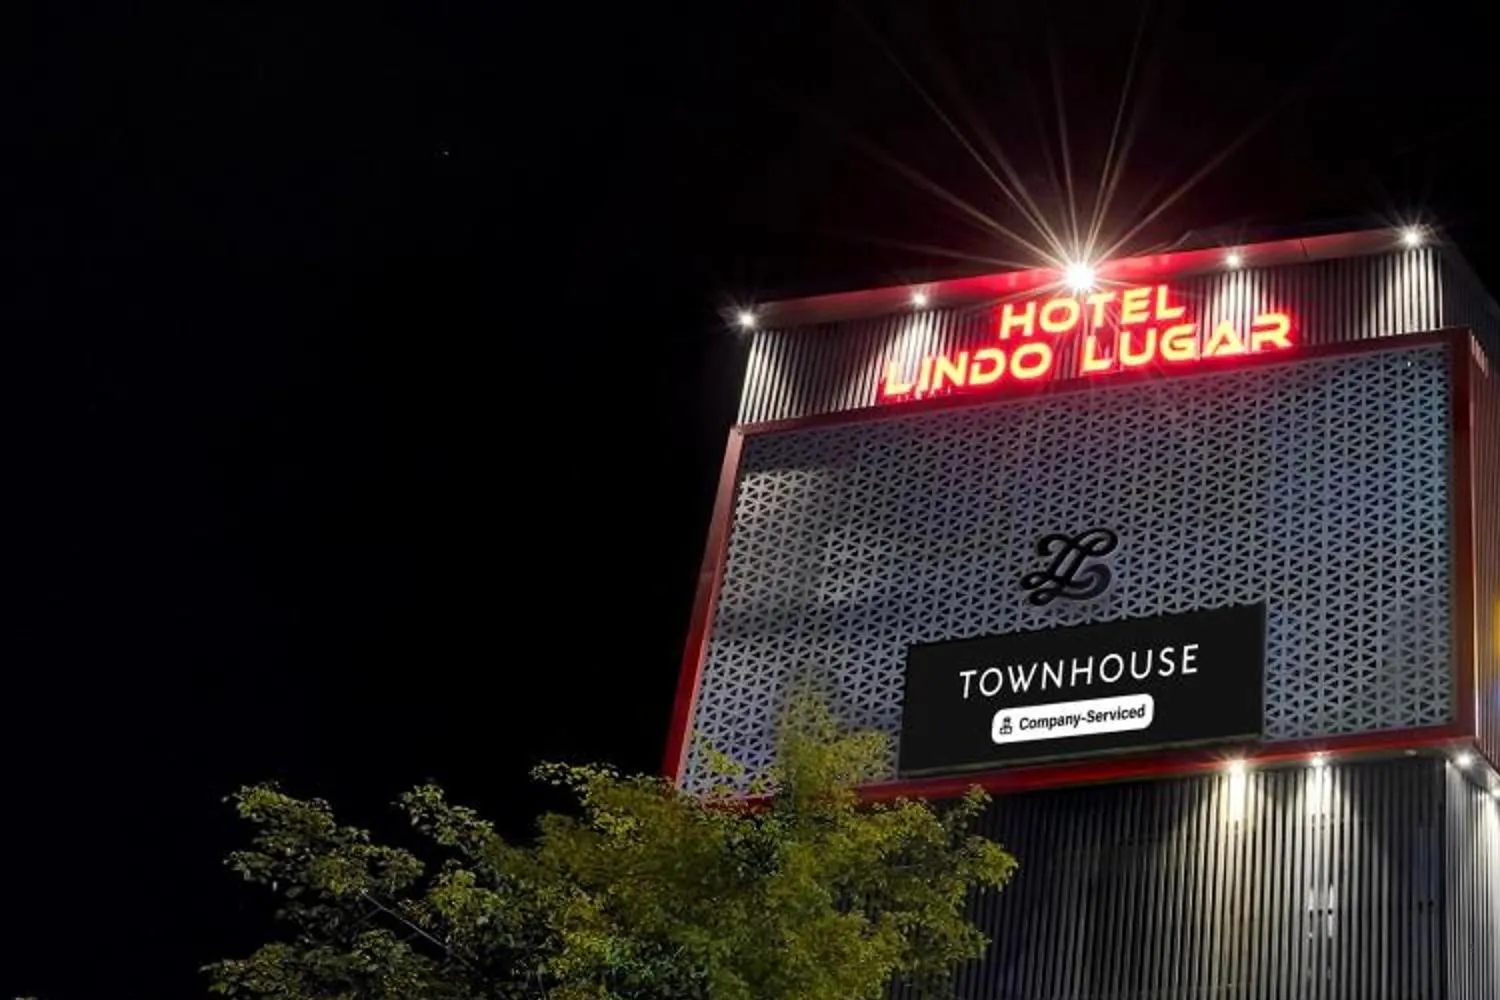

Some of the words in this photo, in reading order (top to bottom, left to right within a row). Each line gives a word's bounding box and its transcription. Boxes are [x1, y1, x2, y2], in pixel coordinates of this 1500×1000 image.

[1000, 285, 1184, 339] HOTEL
[884, 343, 1052, 395] LINDO
[1082, 314, 1292, 372] LUGAR
[959, 644, 1199, 699] TOWNHOUSE
[1018, 704, 1146, 731] Company-Serviced
